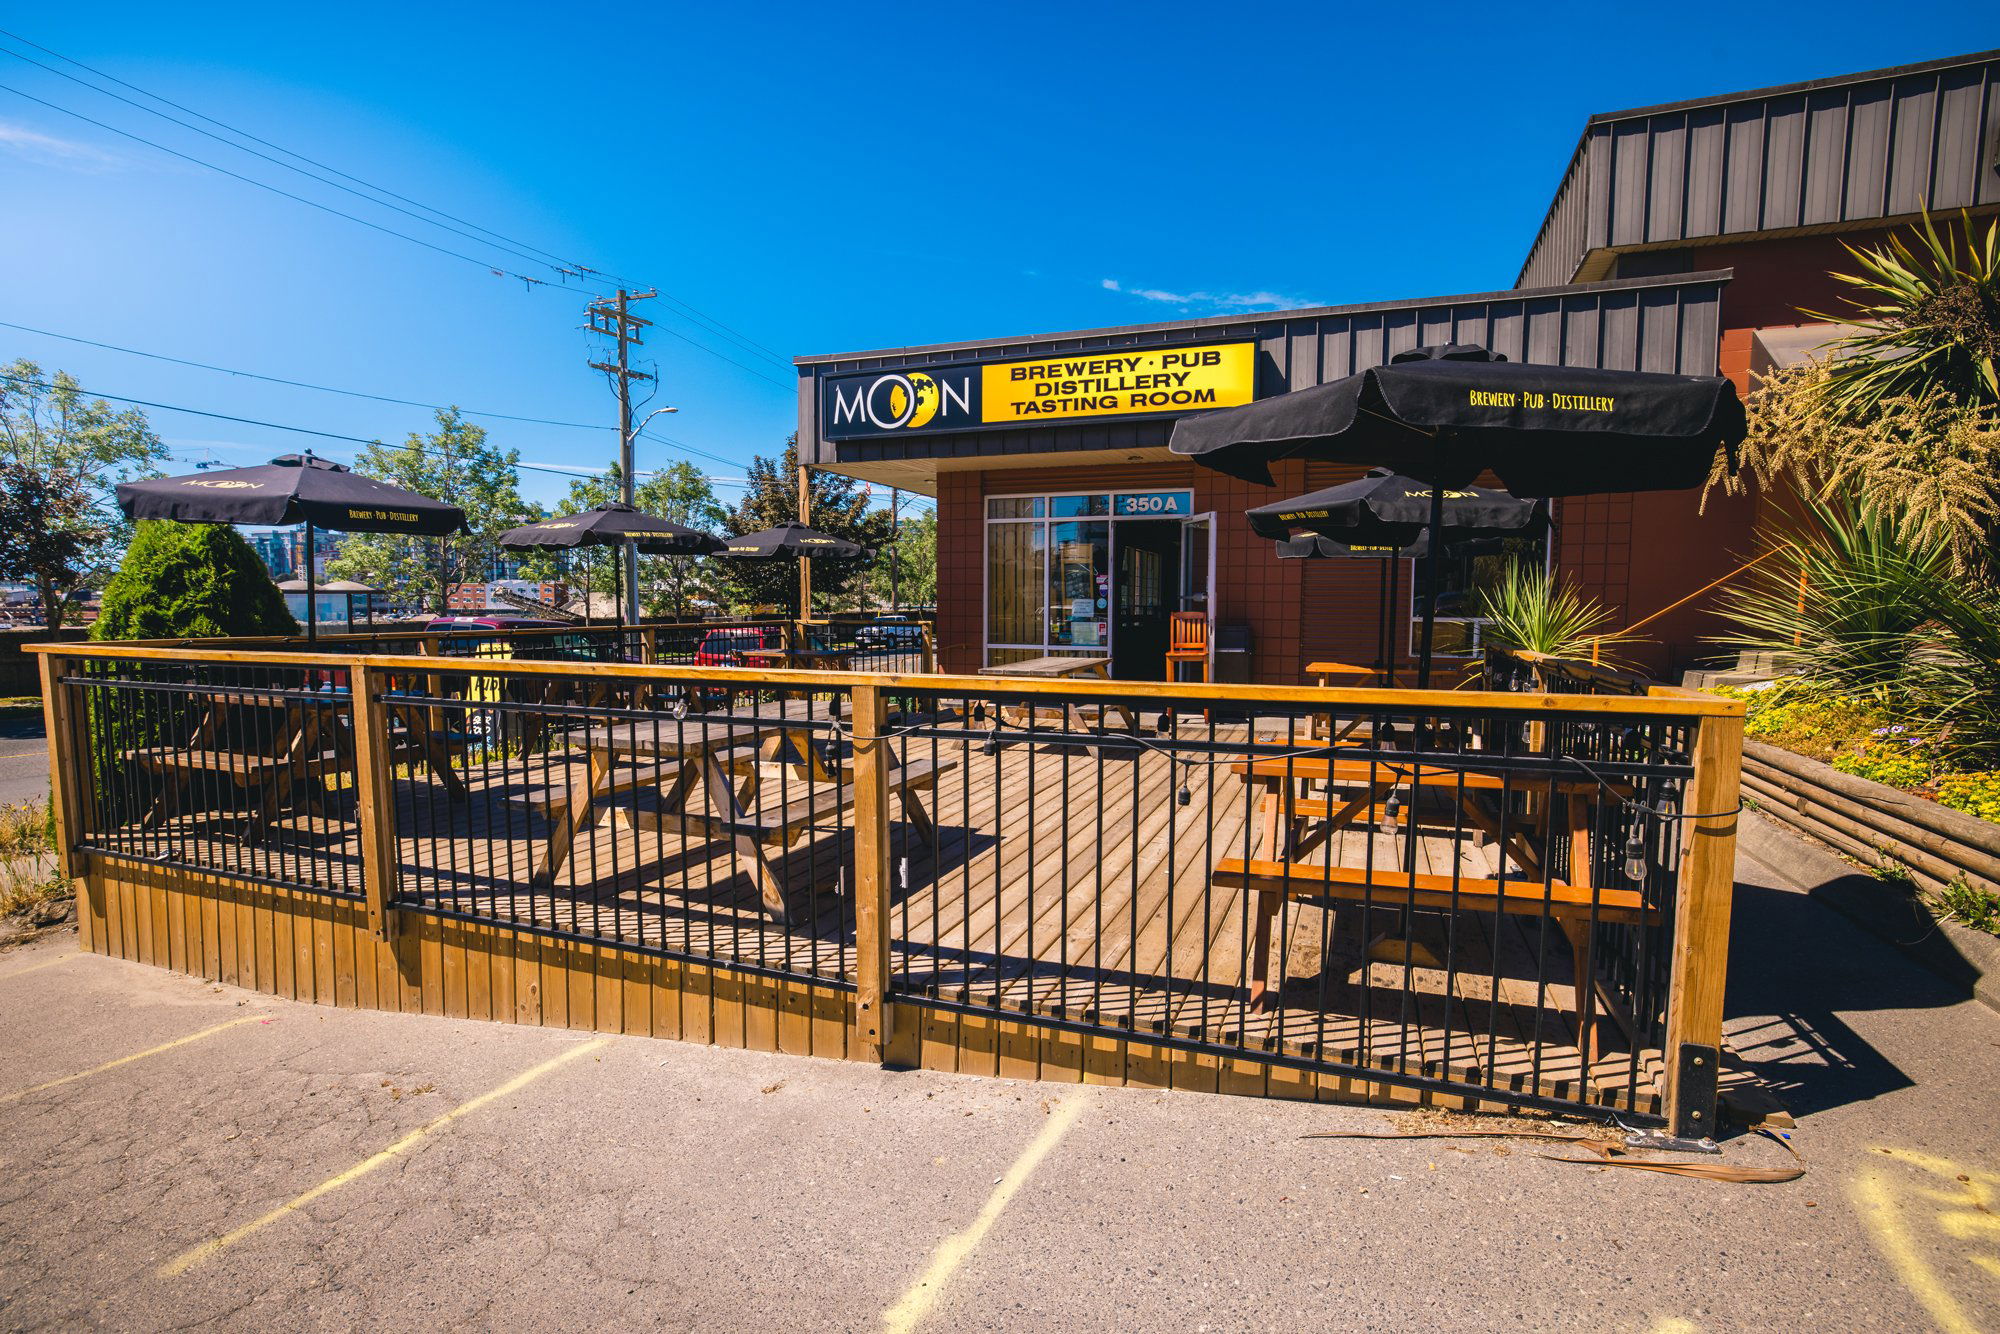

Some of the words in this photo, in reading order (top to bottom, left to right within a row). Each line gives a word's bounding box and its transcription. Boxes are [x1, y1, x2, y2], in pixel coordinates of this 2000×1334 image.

[1010, 356, 1143, 382] BREWERY
[1162, 350, 1221, 370] PUB
[1035, 371, 1191, 397] DISTILLERY
[833, 372, 970, 430] MOON
[1010, 395, 1119, 416] TASTING
[1130, 388, 1216, 408] ROOM
